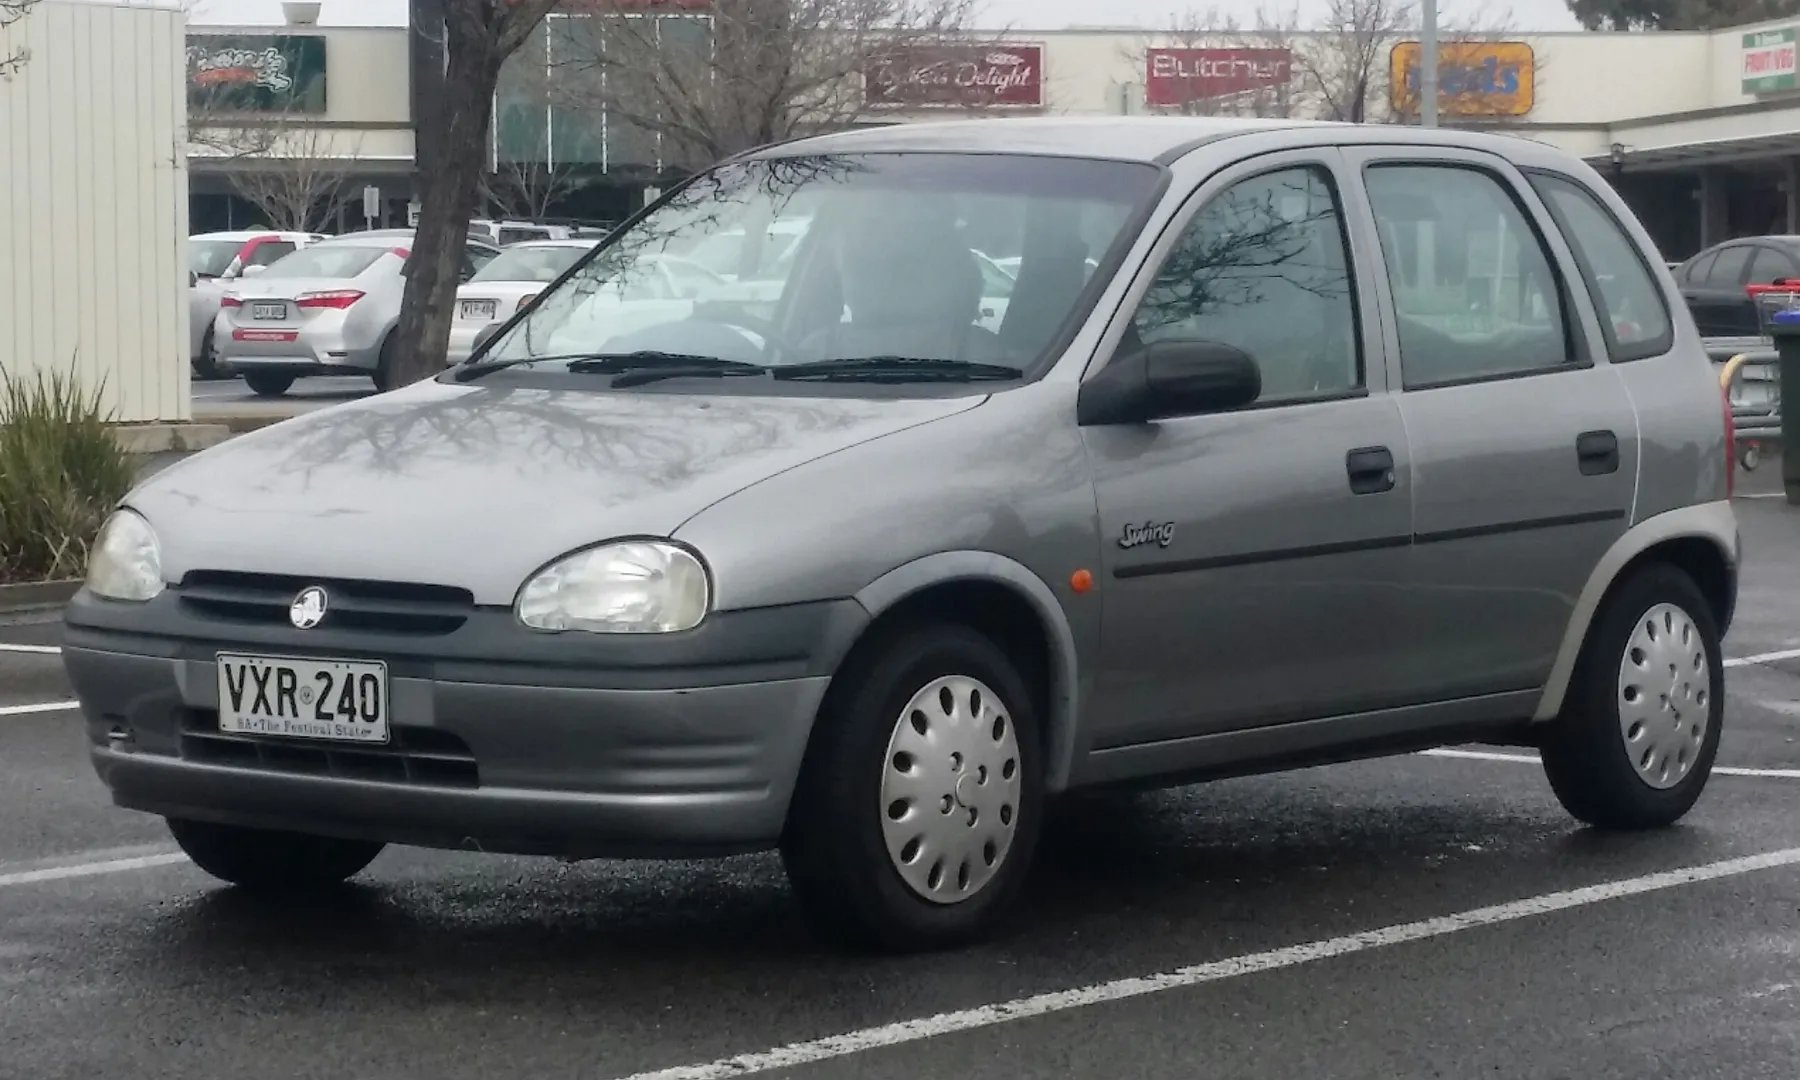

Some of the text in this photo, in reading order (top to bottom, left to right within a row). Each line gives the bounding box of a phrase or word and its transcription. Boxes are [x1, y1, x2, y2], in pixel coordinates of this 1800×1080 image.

[955, 62, 1031, 94] Delight
[1153, 54, 1286, 78] Butcher
[1119, 521, 1175, 549] Swing
[225, 663, 380, 723] VXR 240
[284, 720, 331, 736] Festival
[335, 723, 372, 737] State
